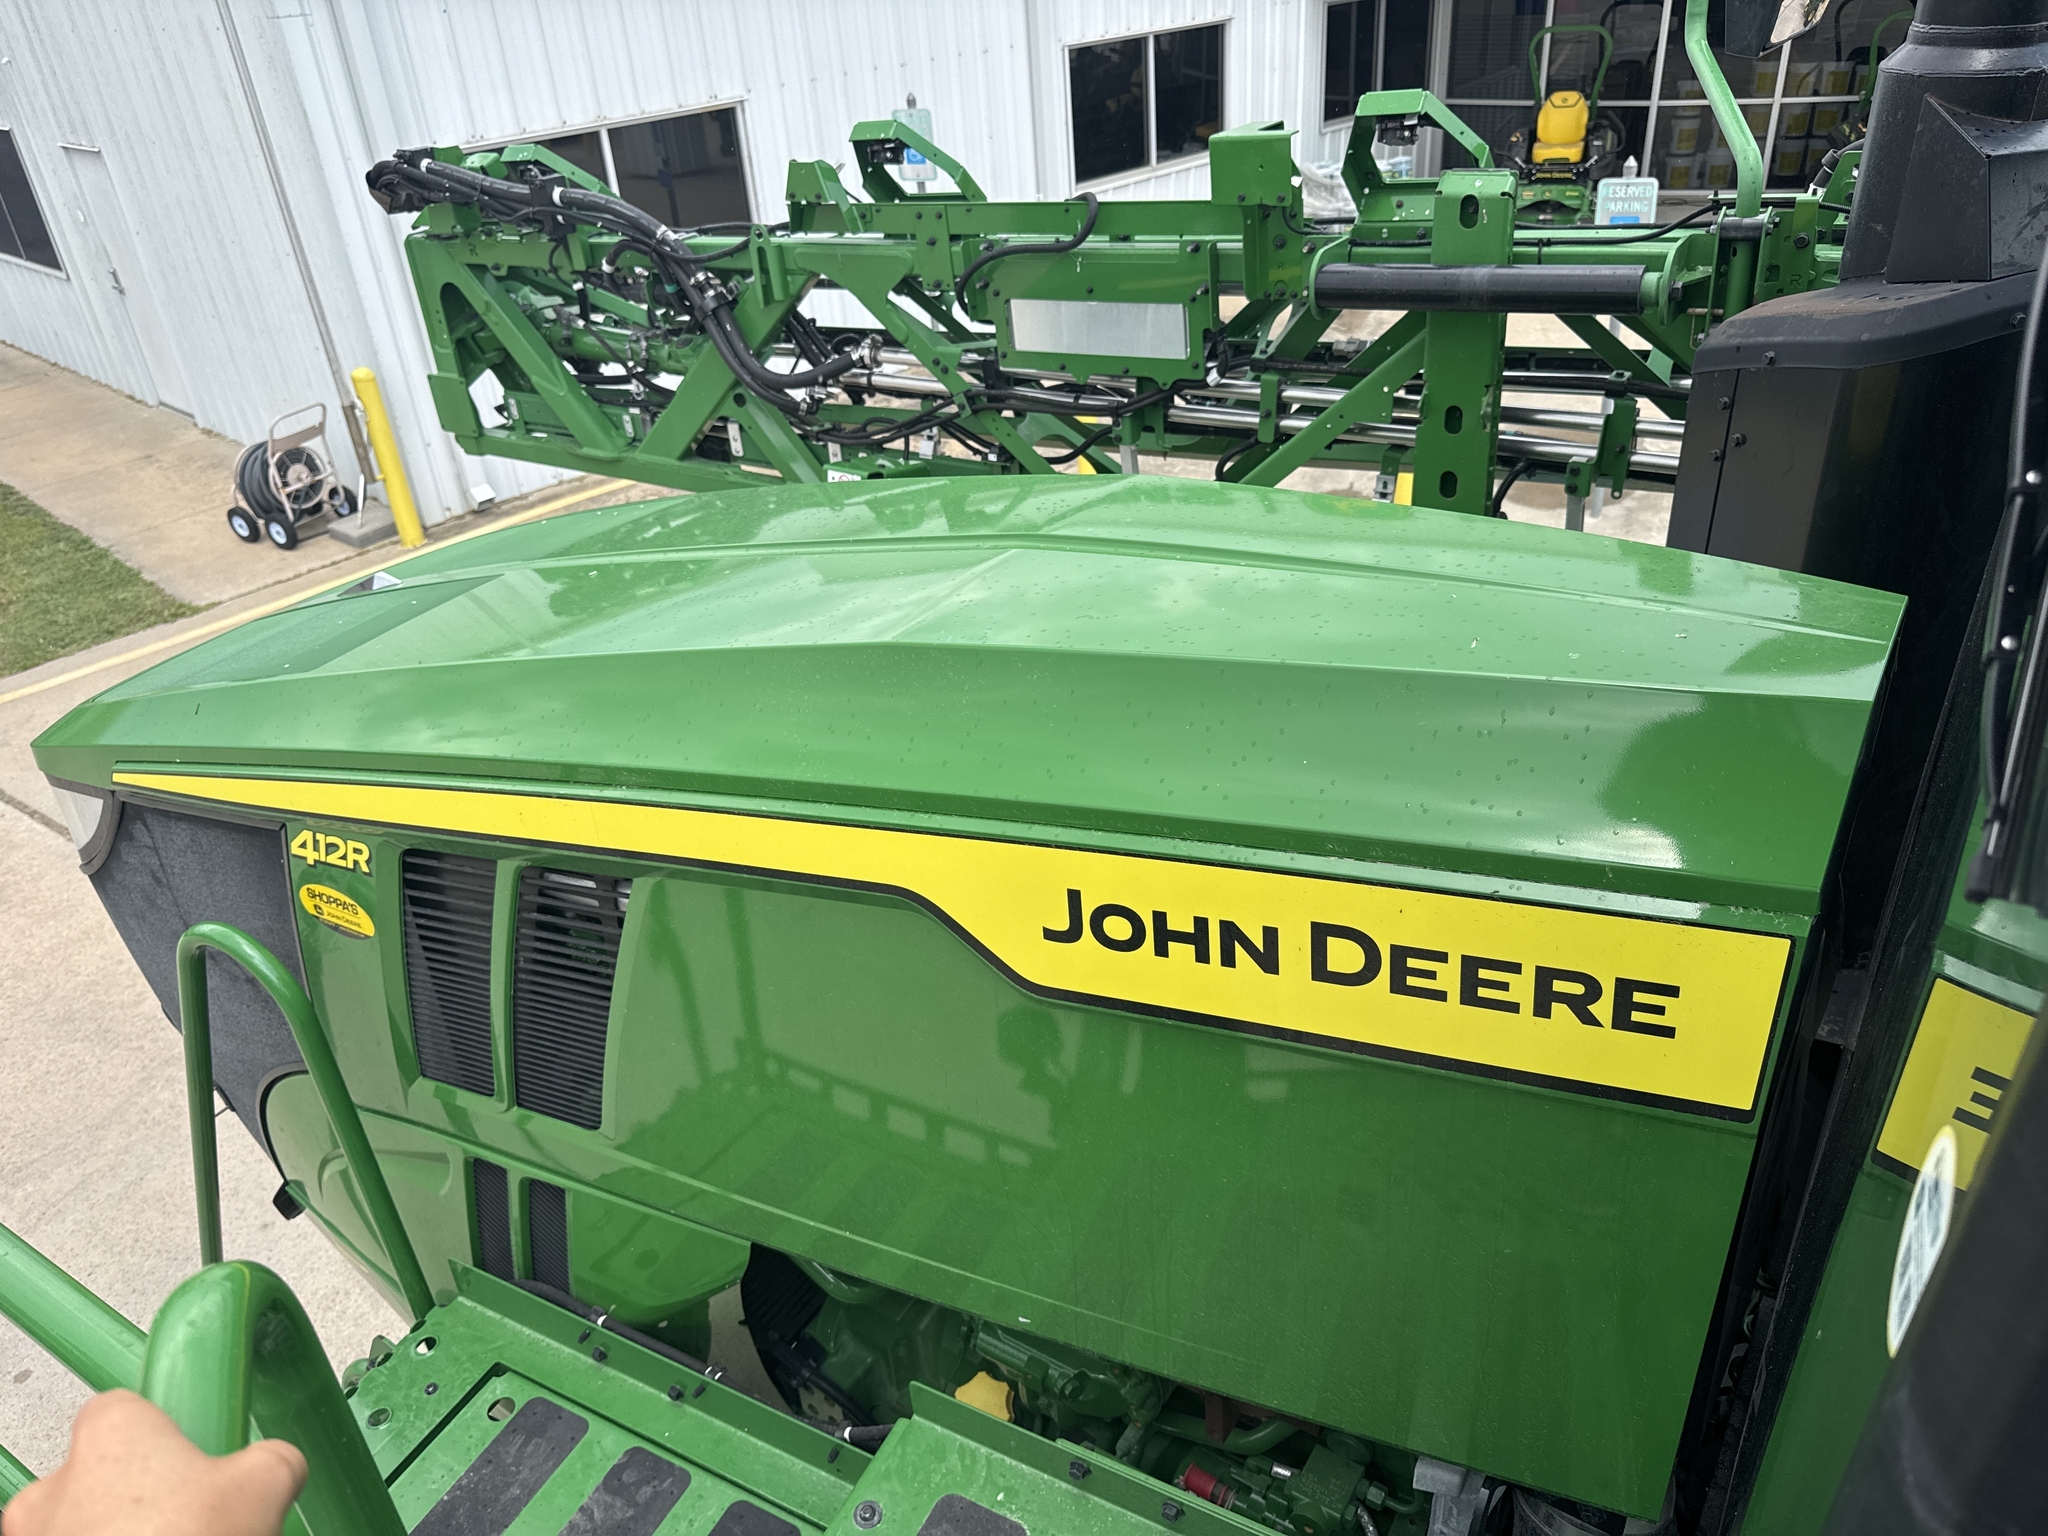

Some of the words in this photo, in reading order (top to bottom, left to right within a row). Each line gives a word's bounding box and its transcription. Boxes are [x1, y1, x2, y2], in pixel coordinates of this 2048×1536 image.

[1604, 201, 1649, 213] PARKING
[291, 829, 371, 873] 412R
[306, 887, 359, 916] SHOPPA'S
[1043, 888, 1280, 976] JOHN
[1310, 920, 1681, 1040] DEERE
